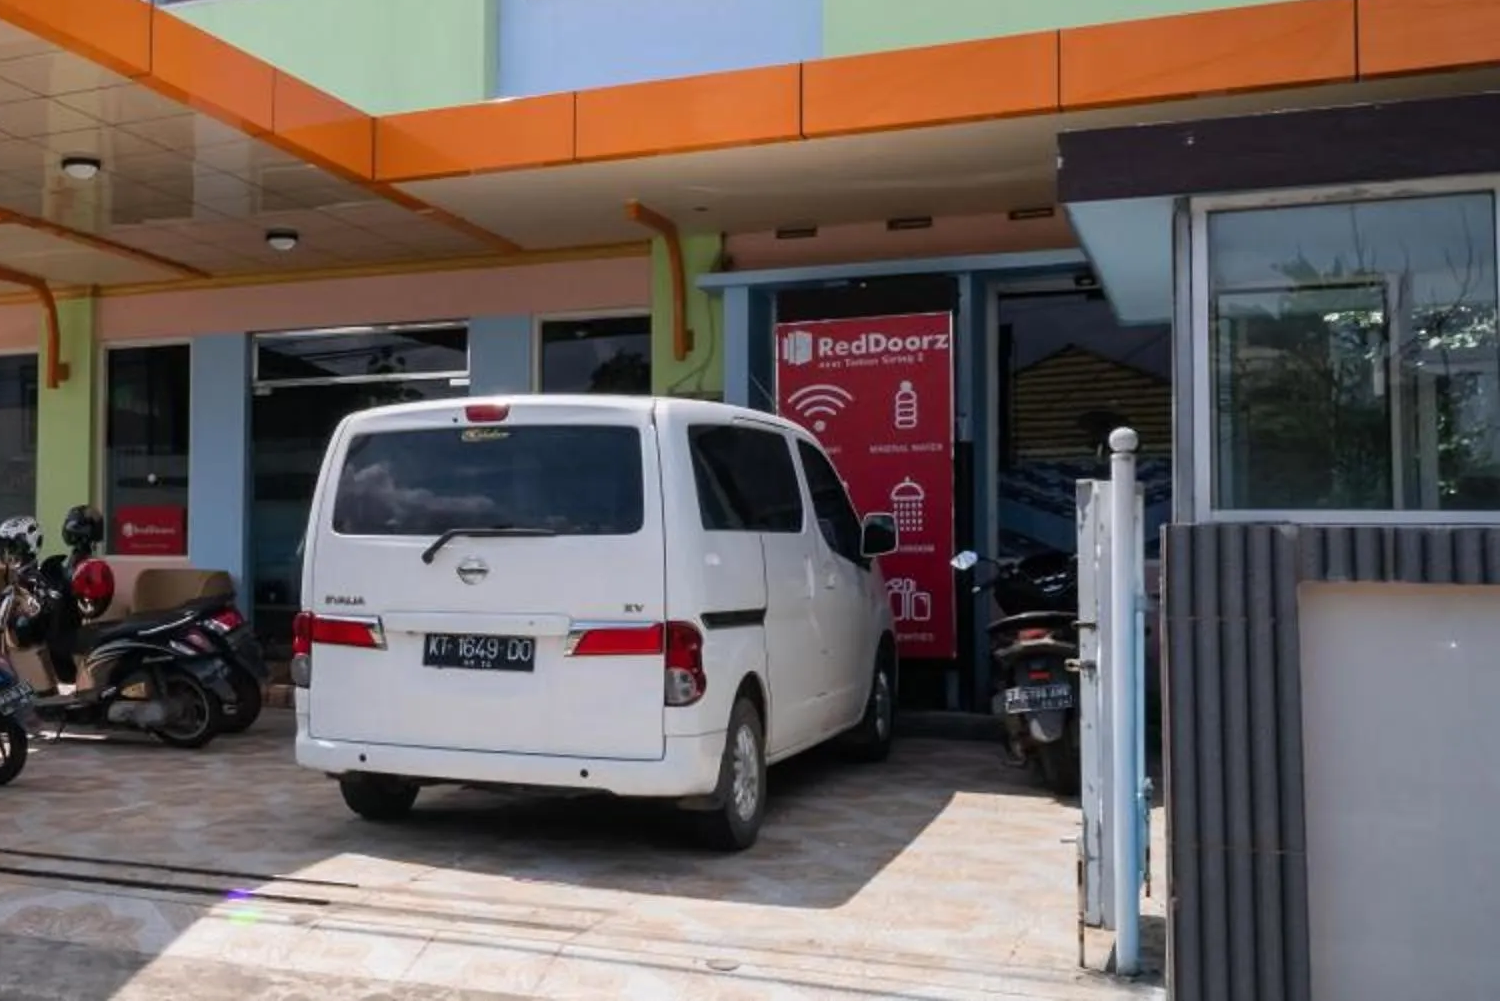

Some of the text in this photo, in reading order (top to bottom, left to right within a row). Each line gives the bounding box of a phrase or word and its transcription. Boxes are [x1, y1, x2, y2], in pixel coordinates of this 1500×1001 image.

[819, 333, 949, 357] RedDoorz
[429, 636, 448, 656] KT
[459, 638, 499, 659] 1649
